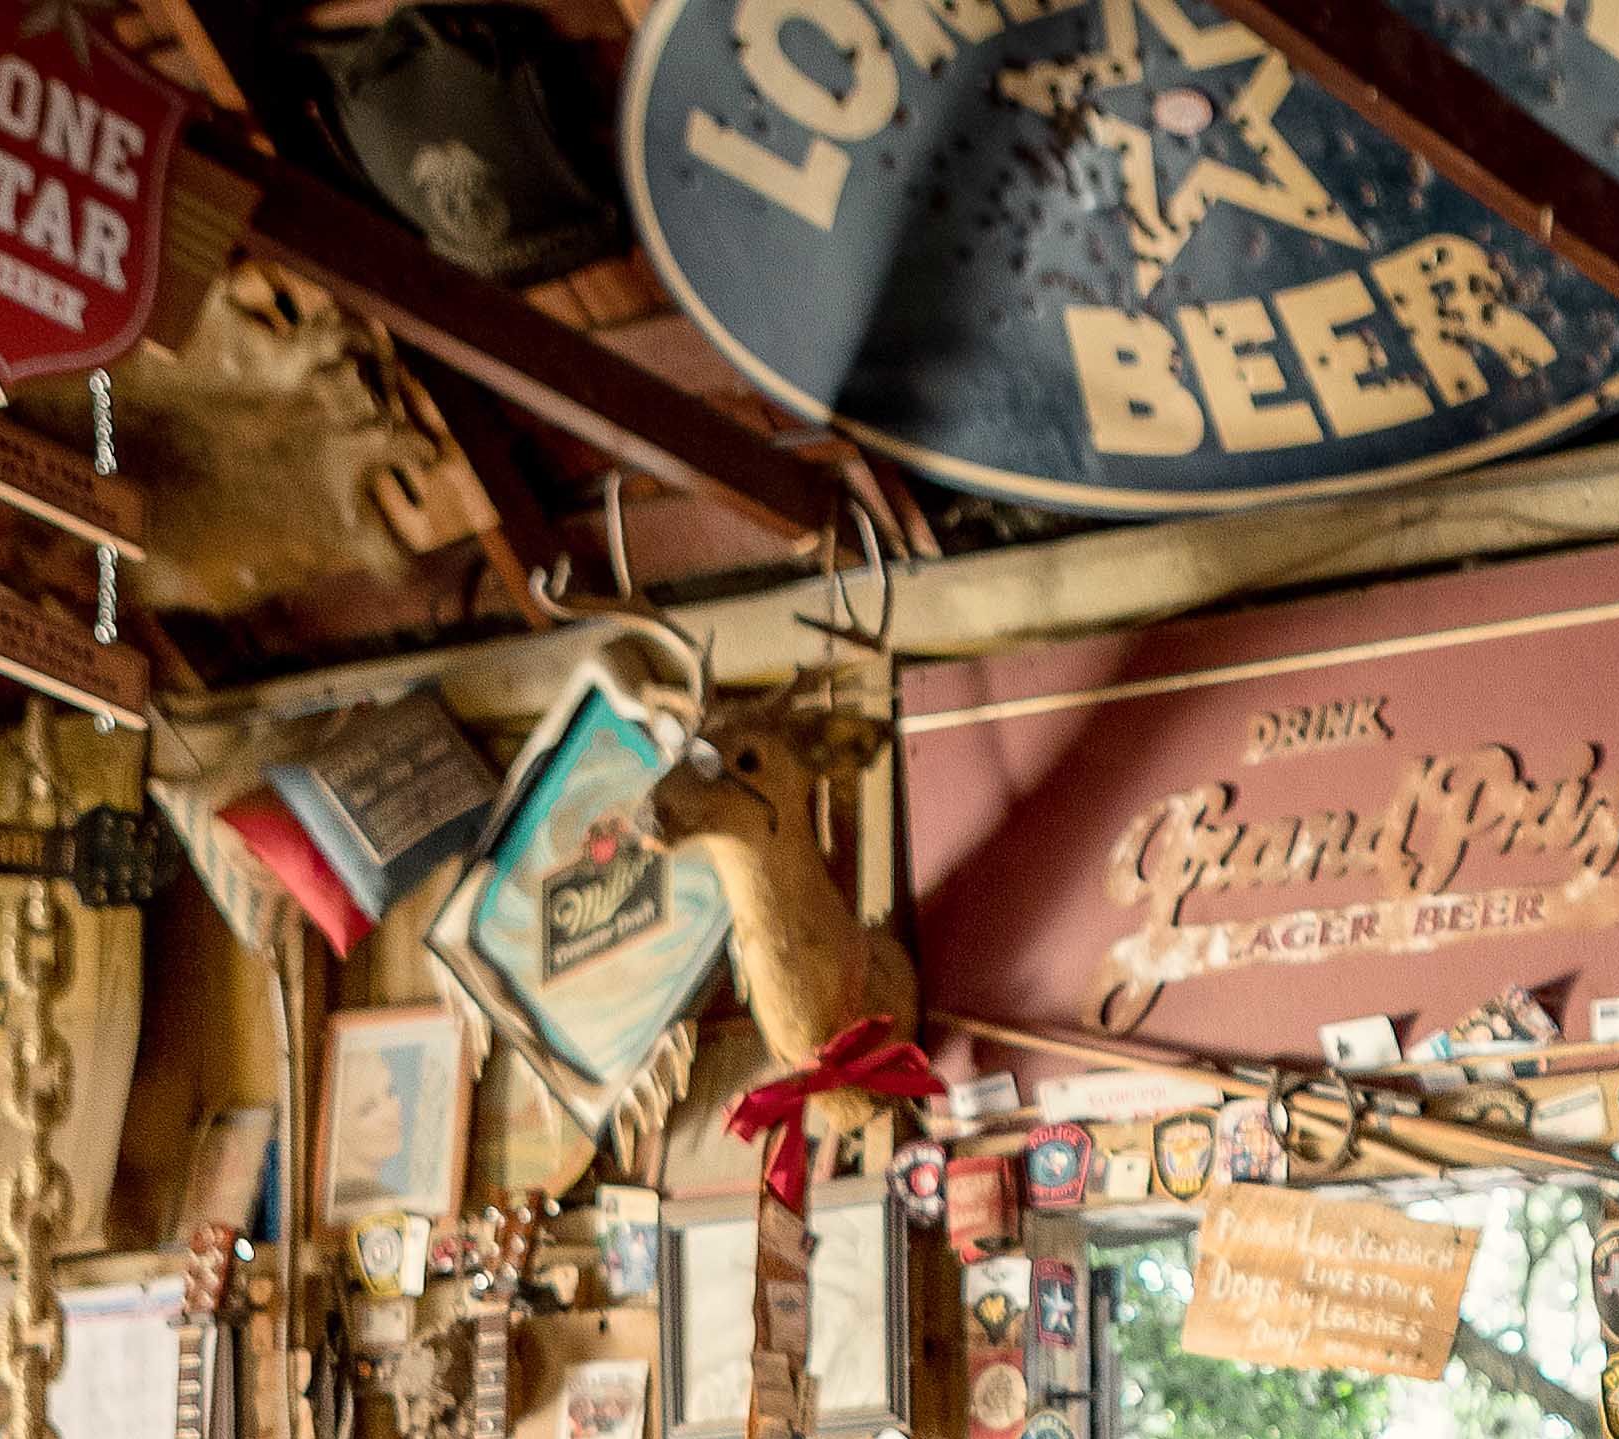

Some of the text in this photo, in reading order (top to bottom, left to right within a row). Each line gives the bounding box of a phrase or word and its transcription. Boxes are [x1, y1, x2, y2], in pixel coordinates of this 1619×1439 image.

[1064, 232, 1558, 458] BEER
[1244, 696, 1397, 764] DRINK
[1414, 893, 1550, 939] BEER
